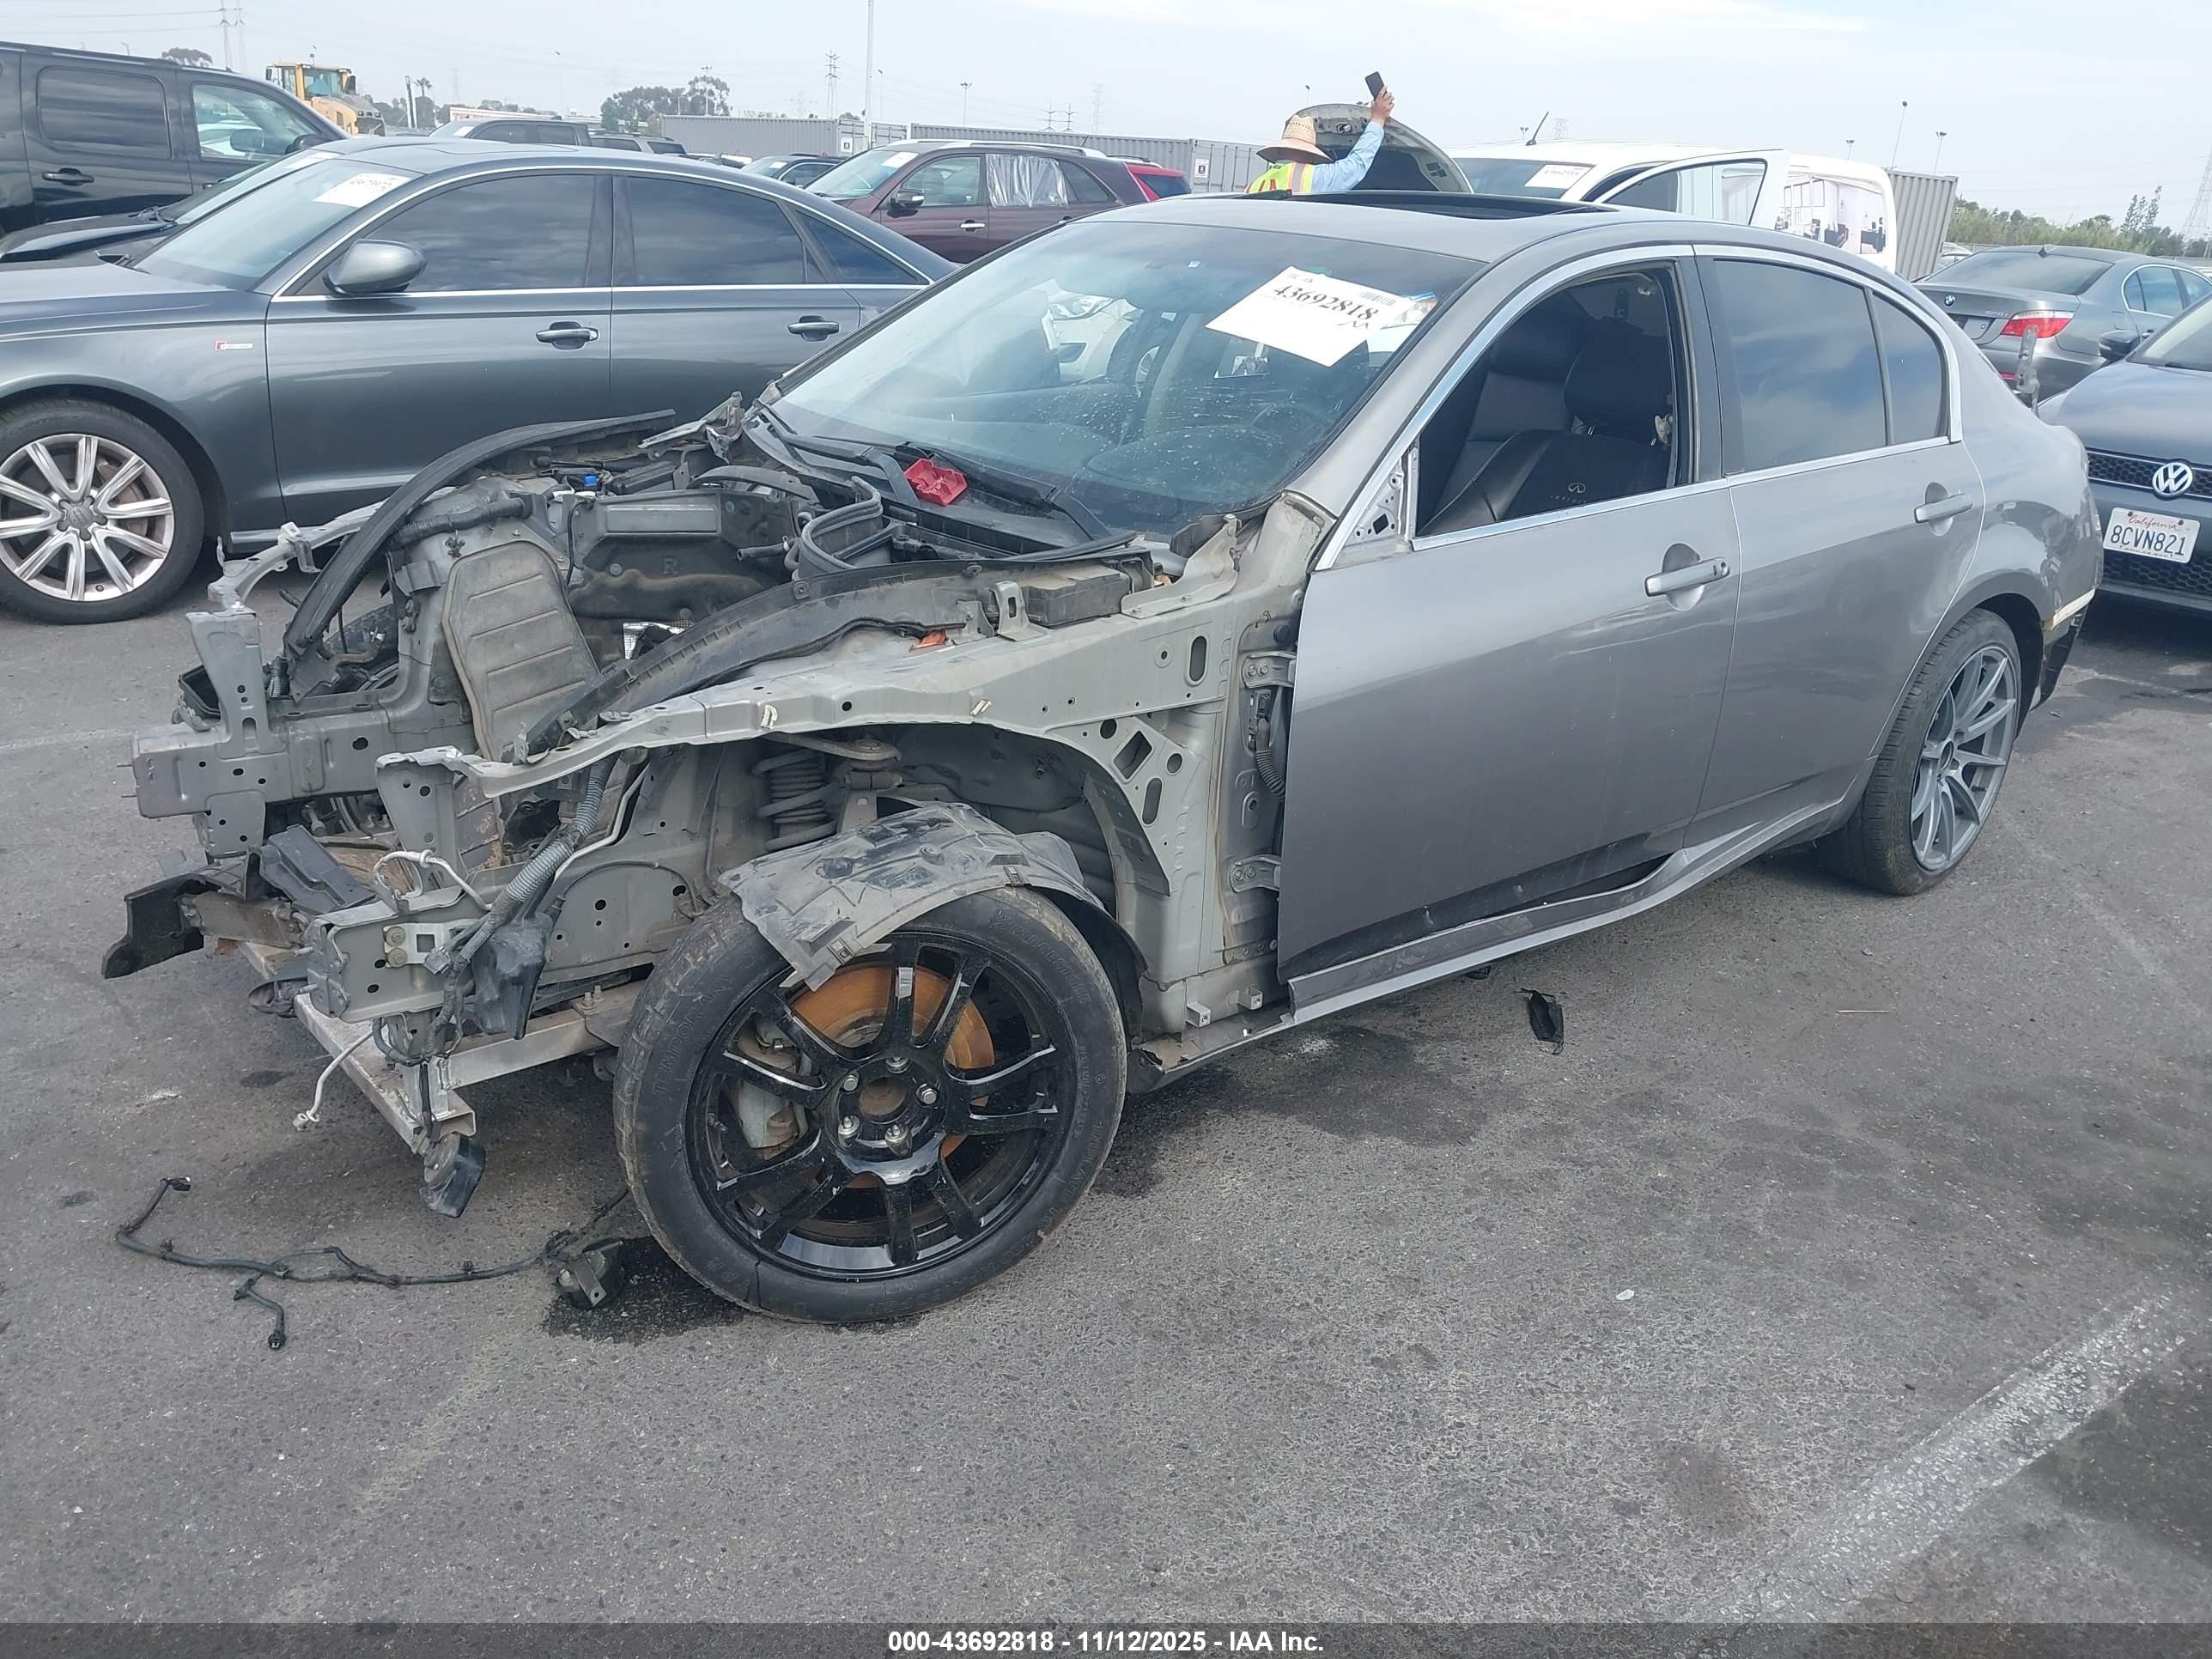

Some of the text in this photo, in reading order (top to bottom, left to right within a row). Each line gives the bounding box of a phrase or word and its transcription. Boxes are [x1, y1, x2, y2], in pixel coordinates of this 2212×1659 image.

[1273, 283, 1380, 321] 43692818
[2128, 513, 2182, 532] California
[2111, 525, 2187, 556] 8CVN821
